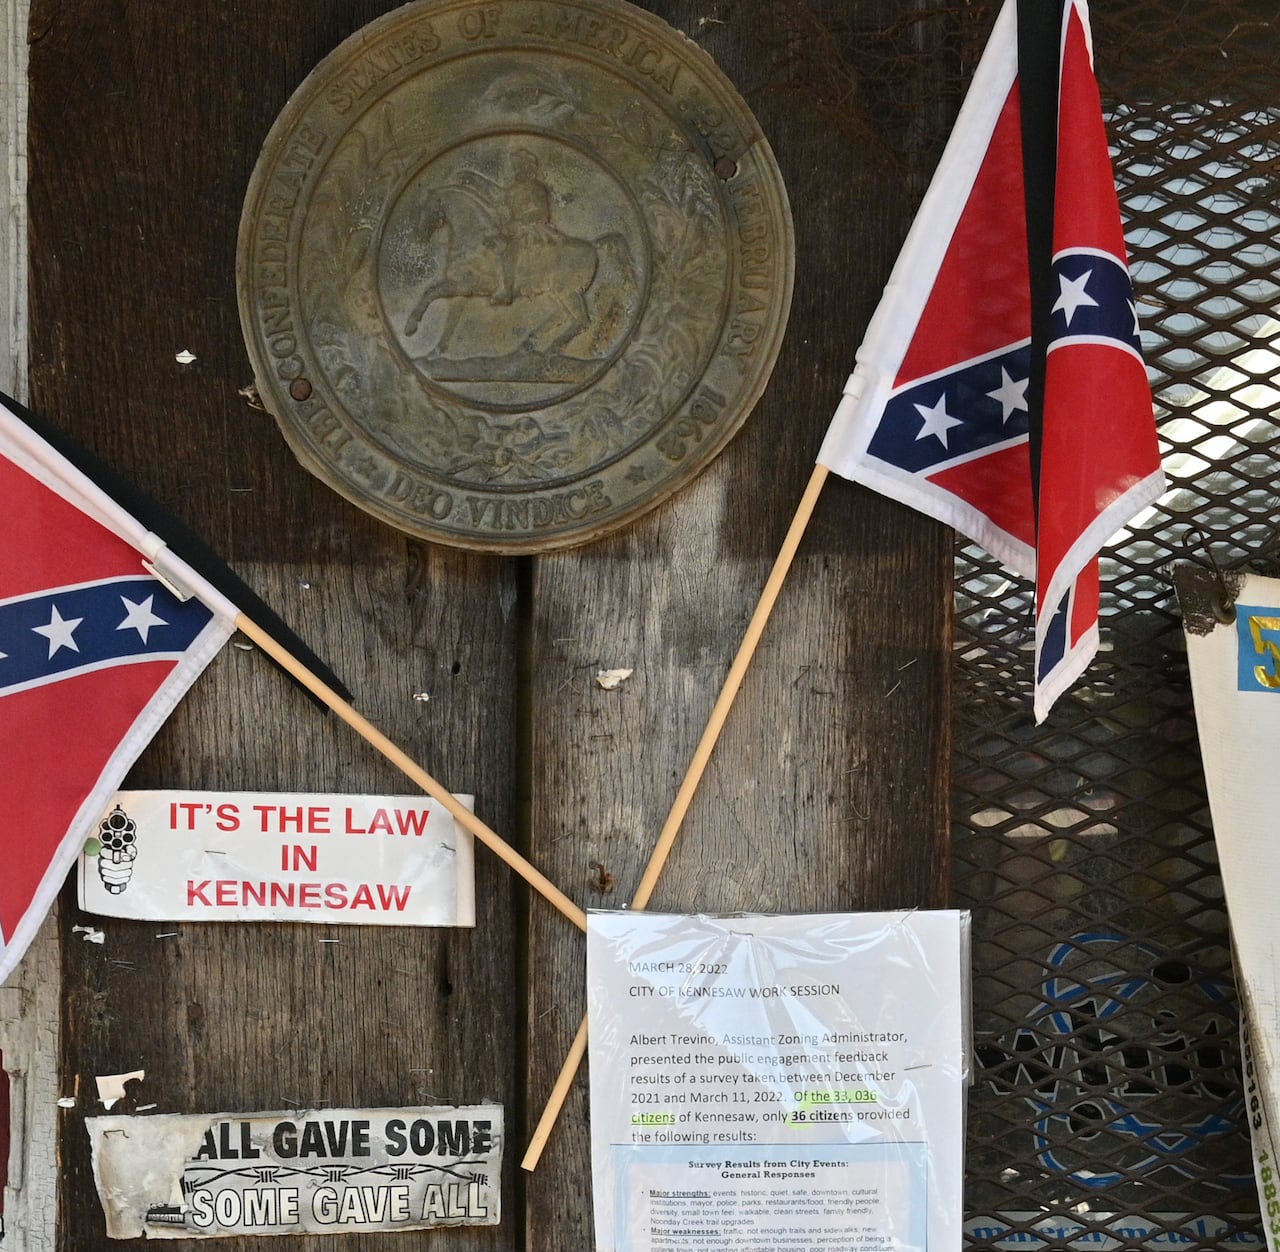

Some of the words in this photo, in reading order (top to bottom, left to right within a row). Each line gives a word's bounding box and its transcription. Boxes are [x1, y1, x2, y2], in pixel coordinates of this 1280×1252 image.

[258, 123, 330, 381] CONFEDERATE
[326, 22, 441, 115] STATES
[457, 8, 503, 41] OF
[520, 8, 683, 98] AMERICA
[382, 471, 455, 524] DEO
[467, 477, 613, 530] VINDICE
[170, 802, 241, 833] IT'S
[253, 805, 332, 835] THE
[345, 807, 430, 837] LAW
[281, 844, 318, 872] IN
[186, 880, 411, 911] KENNESAW
[629, 962, 674, 973] MARCH
[700, 964, 728, 975] 2022
[629, 986, 655, 997] CITY
[658, 986, 675, 997] OF
[678, 986, 746, 998] KENNESAW
[749, 987, 787, 998] WORK
[790, 984, 840, 996] SESSION
[630, 1034, 666, 1045] Albert
[670, 1034, 718, 1046] Trevino,
[723, 1034, 776, 1046] Assistant
[778, 1033, 818, 1047] Zoning
[822, 1032, 908, 1046] Administrator,
[630, 1053, 692, 1067] presented
[695, 1052, 715, 1065] the
[718, 1052, 754, 1067] public
[757, 1054, 831, 1067] engagement
[834, 1050, 889, 1063] feedback
[630, 1072, 671, 1084] results
[674, 1072, 686, 1084] of
[689, 1075, 696, 1084] a
[699, 1074, 740, 1087] survey
[742, 1072, 776, 1083] taken
[779, 1071, 831, 1083] between
[834, 1069, 896, 1082] December
[631, 1092, 660, 1104] 2021
[664, 1092, 686, 1104] and
[690, 1092, 728, 1103] March
[732, 1092, 750, 1105] 11,
[794, 1090, 809, 1102] Of
[811, 1089, 830, 1101] the
[833, 1090, 851, 1103] 33,
[855, 1089, 877, 1101] 036
[631, 1112, 675, 1123] citizens
[679, 1111, 692, 1122] of
[695, 1111, 759, 1124] Kennesaw,
[762, 1110, 788, 1124] only
[791, 1110, 807, 1121] 36
[809, 1109, 854, 1121] citizens
[857, 1108, 910, 1122] provided
[192, 1122, 260, 1161] ALL
[272, 1120, 371, 1159] GAVE
[384, 1119, 492, 1157] SOME
[191, 1187, 300, 1227] SOME
[312, 1185, 412, 1225] GAVE
[421, 1182, 488, 1220] ALL
